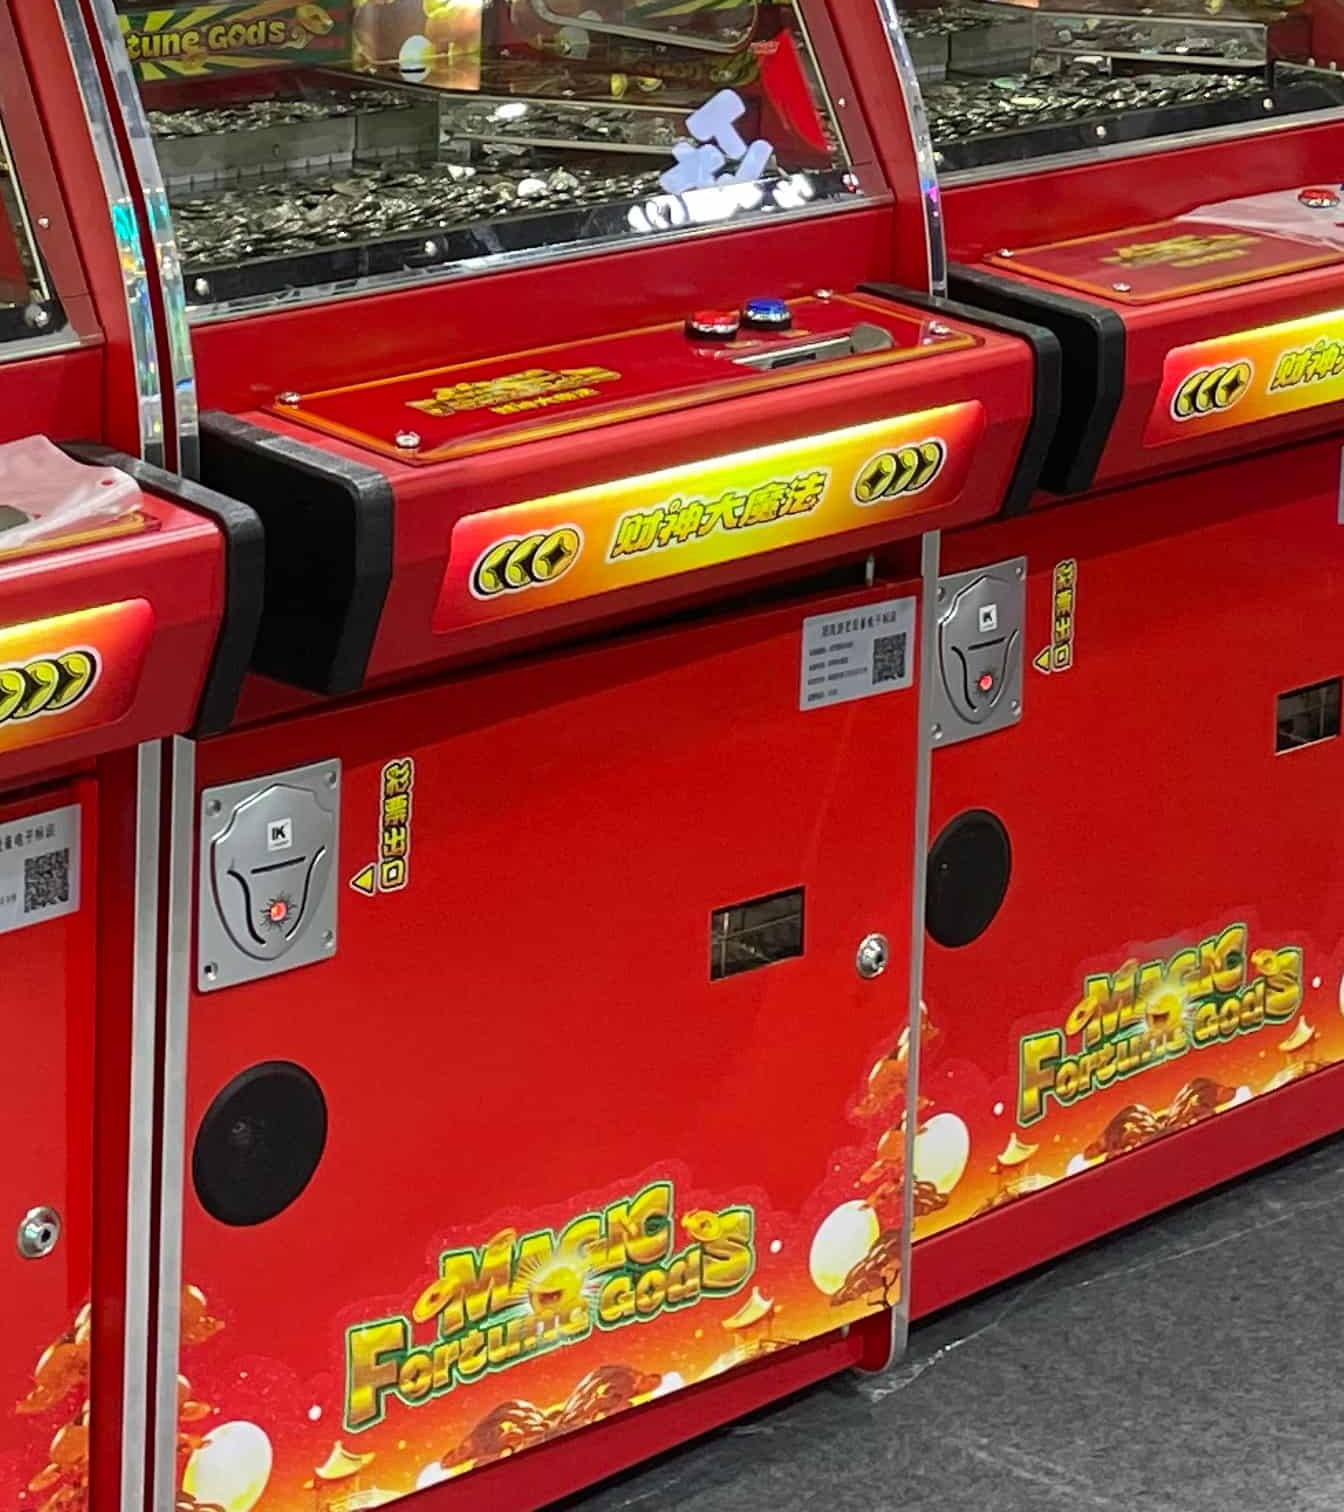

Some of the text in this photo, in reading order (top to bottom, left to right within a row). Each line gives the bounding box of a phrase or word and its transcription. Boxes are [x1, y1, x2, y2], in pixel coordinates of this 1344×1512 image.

[608, 468, 830, 562] 财神大魔法
[381, 760, 412, 888] 彩票出口
[1083, 923, 1247, 1048] MAGIC
[439, 1180, 674, 1336] MAGIC
